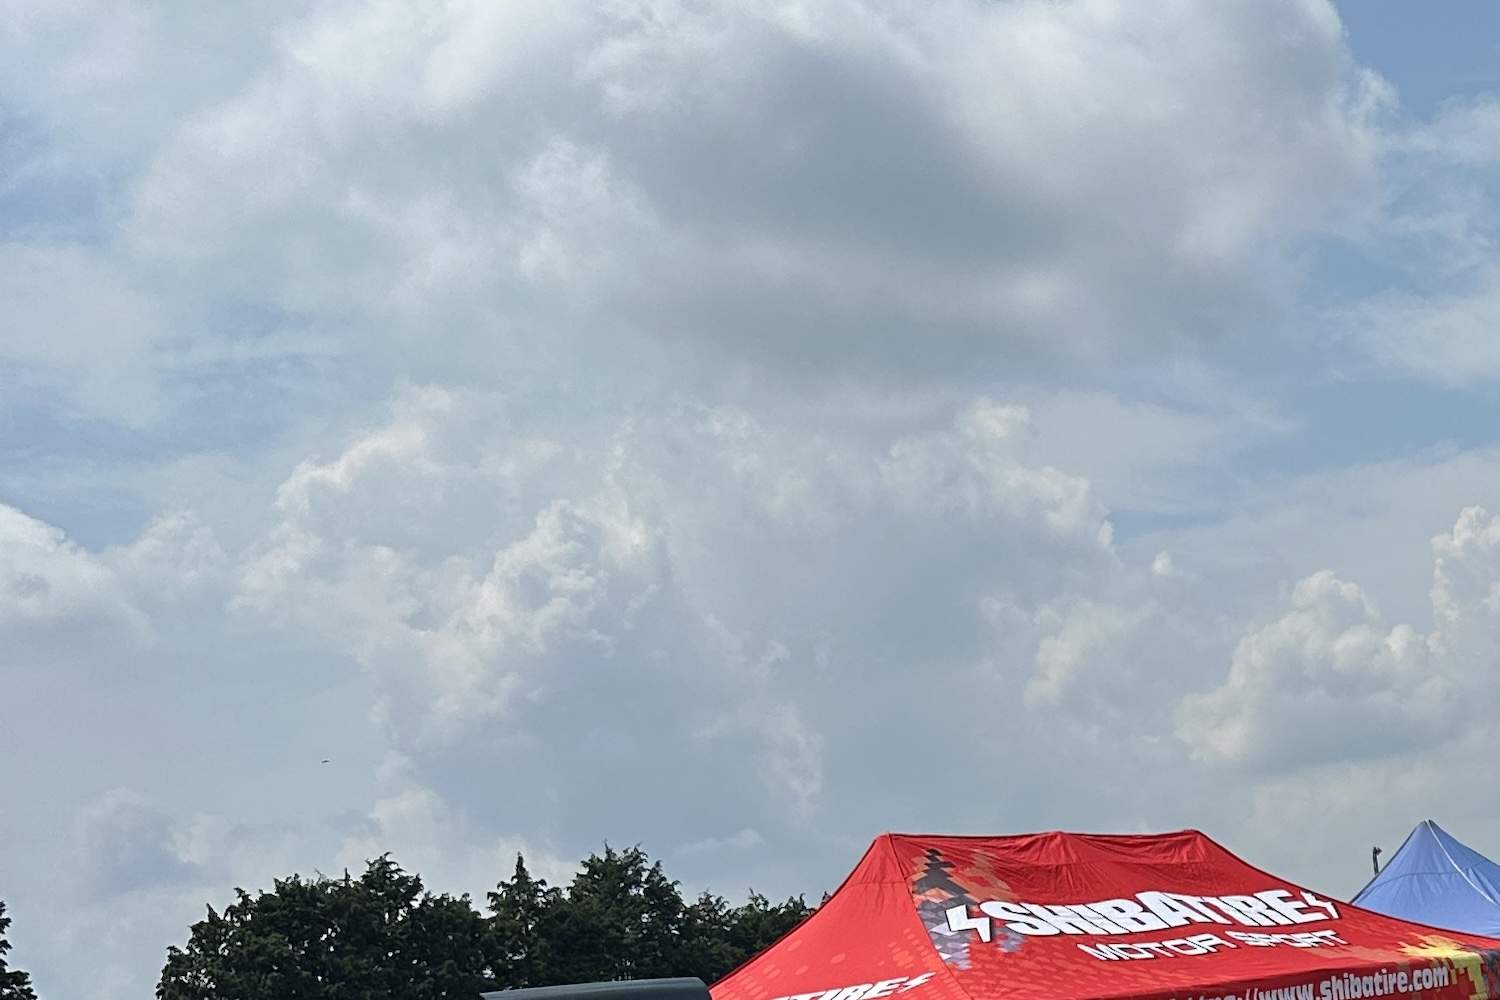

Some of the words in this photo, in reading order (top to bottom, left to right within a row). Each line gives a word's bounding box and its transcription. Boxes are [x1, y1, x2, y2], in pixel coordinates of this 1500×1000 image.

[980, 890, 1330, 935] SHIBATIRE
[1077, 933, 1237, 960] MOTOR
[1225, 930, 1348, 948] SPORT
